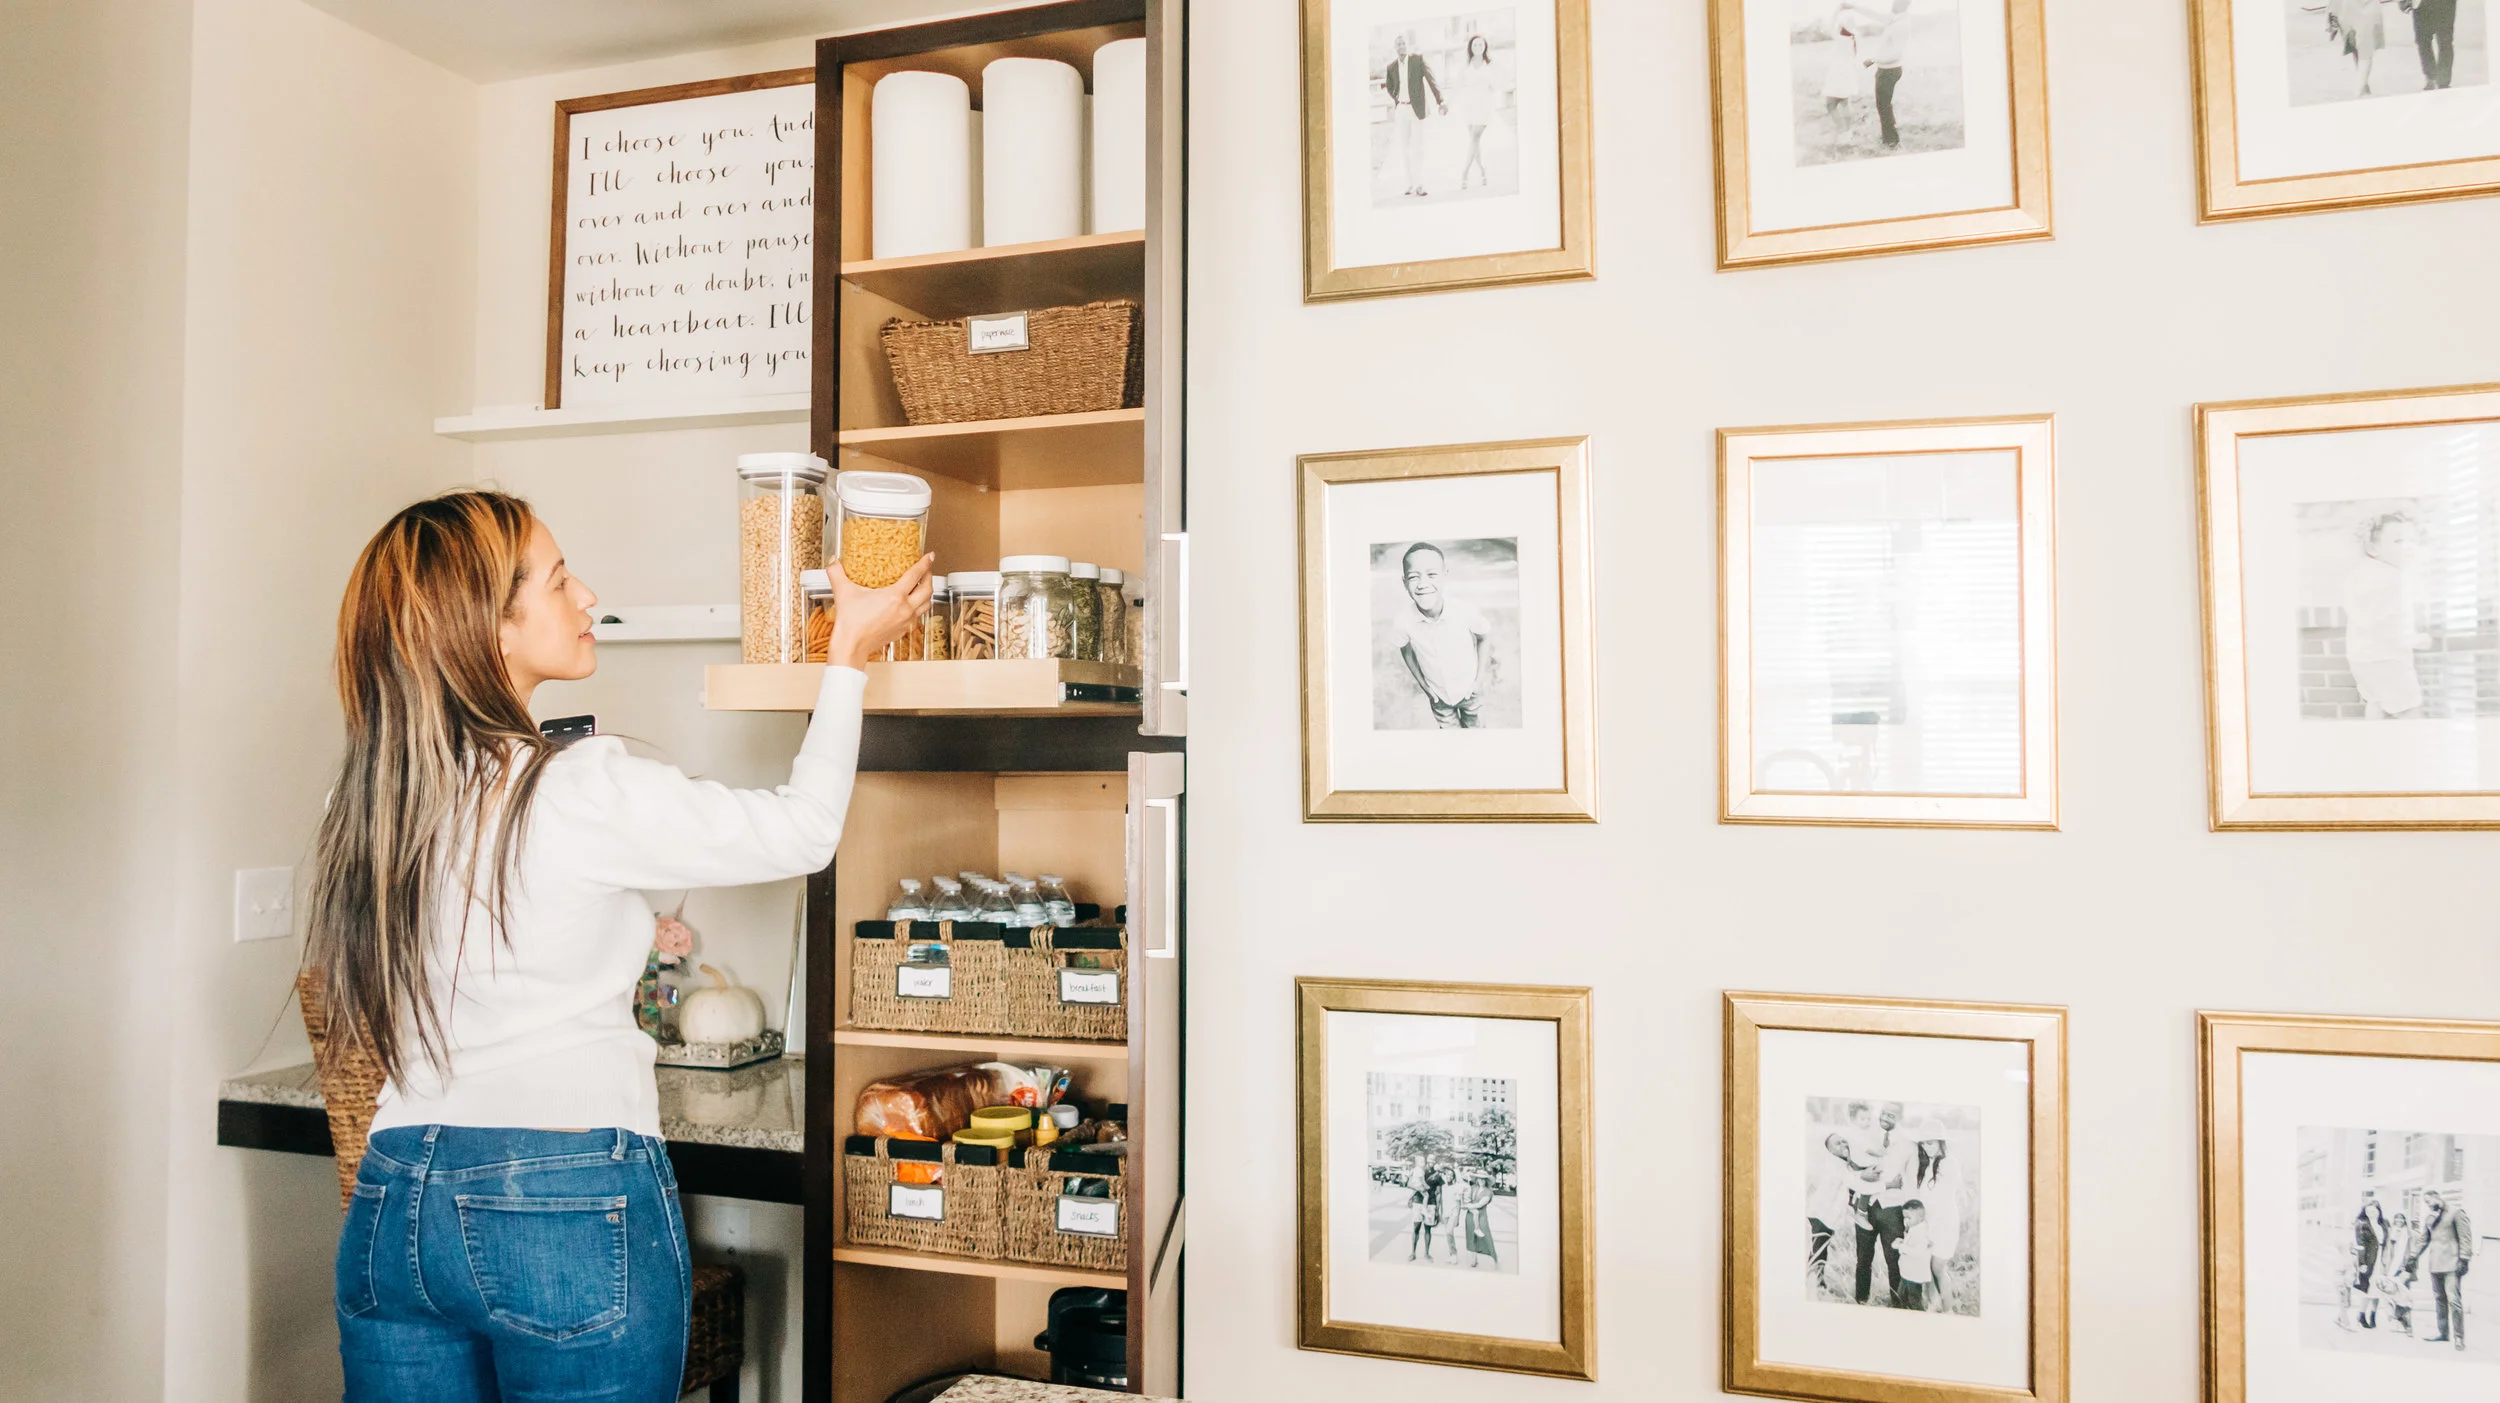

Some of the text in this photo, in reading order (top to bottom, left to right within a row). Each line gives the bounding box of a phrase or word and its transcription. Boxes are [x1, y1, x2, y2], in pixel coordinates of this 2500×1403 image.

[583, 111, 813, 160] I choose you. And
[589, 169, 631, 196] I'll
[657, 160, 736, 184] choose
[579, 186, 813, 228] over and over and
[633, 234, 732, 265] Without
[746, 233, 812, 259] pause
[576, 277, 661, 306] without
[674, 283, 690, 295] a
[787, 267, 809, 289] in
[575, 328, 594, 341] a
[768, 301, 812, 329] I'll
[573, 348, 809, 382] keep choosing you
